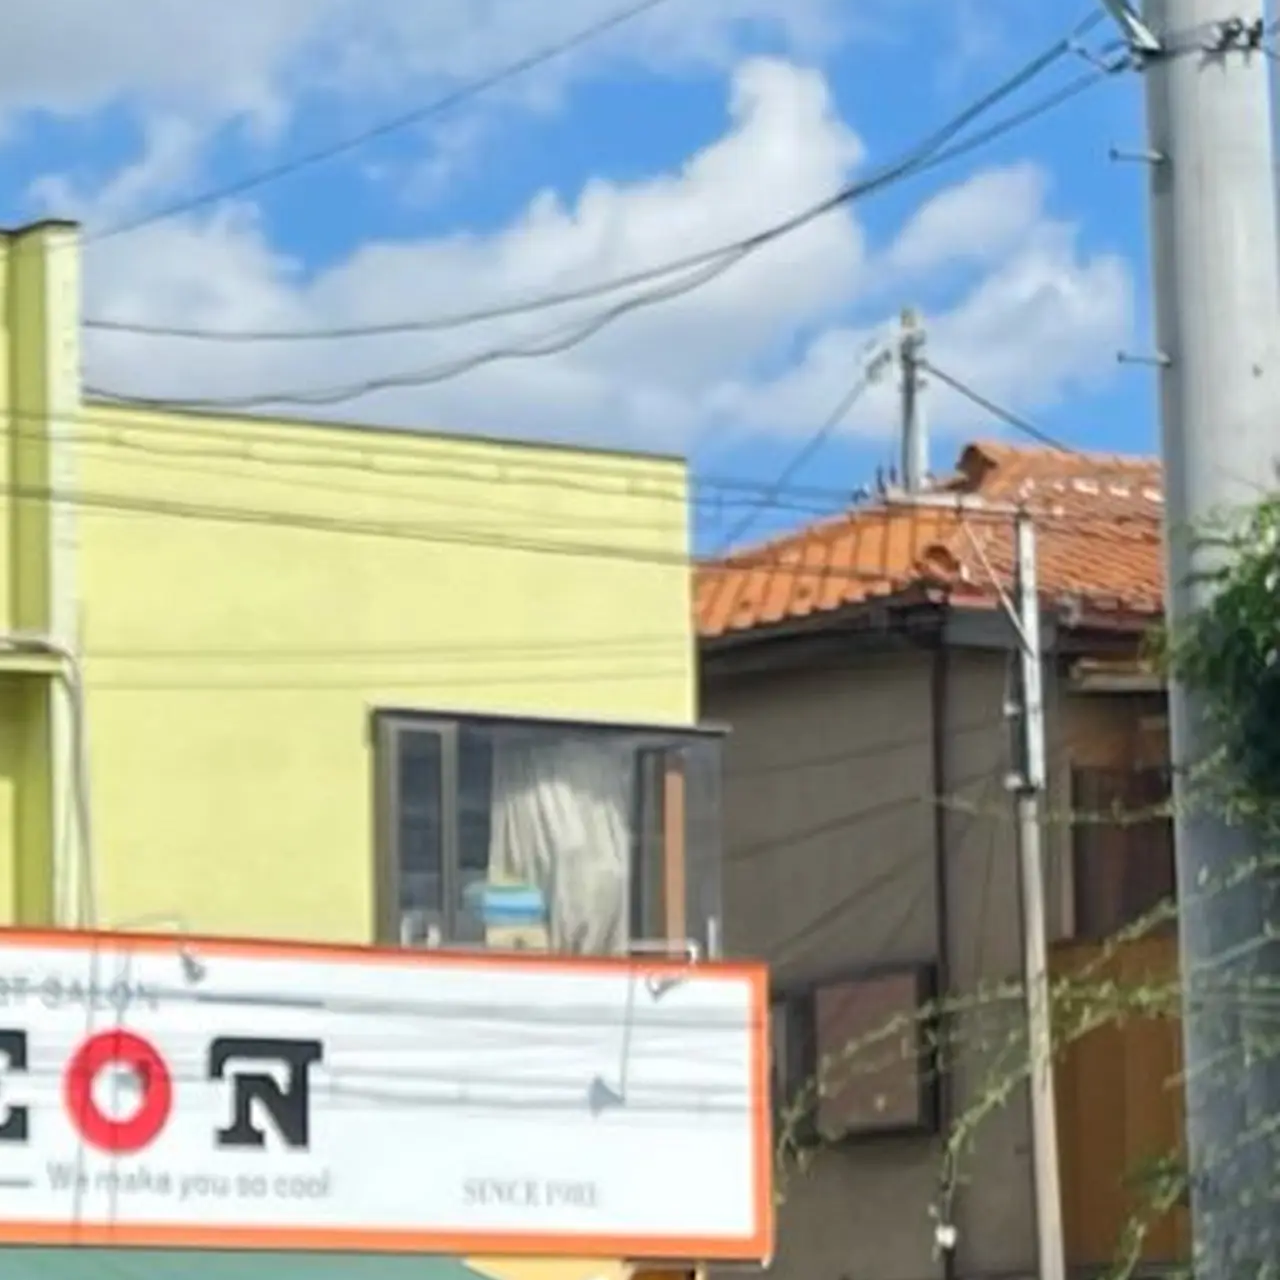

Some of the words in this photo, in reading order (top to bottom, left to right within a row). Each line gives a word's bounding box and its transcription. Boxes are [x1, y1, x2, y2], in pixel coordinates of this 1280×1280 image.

[39, 975, 161, 1014] SALON
[47, 1161, 89, 1195] We
[94, 1166, 172, 1197] make
[178, 1173, 231, 1201] you
[236, 1175, 267, 1199] so
[272, 1167, 329, 1200] cool
